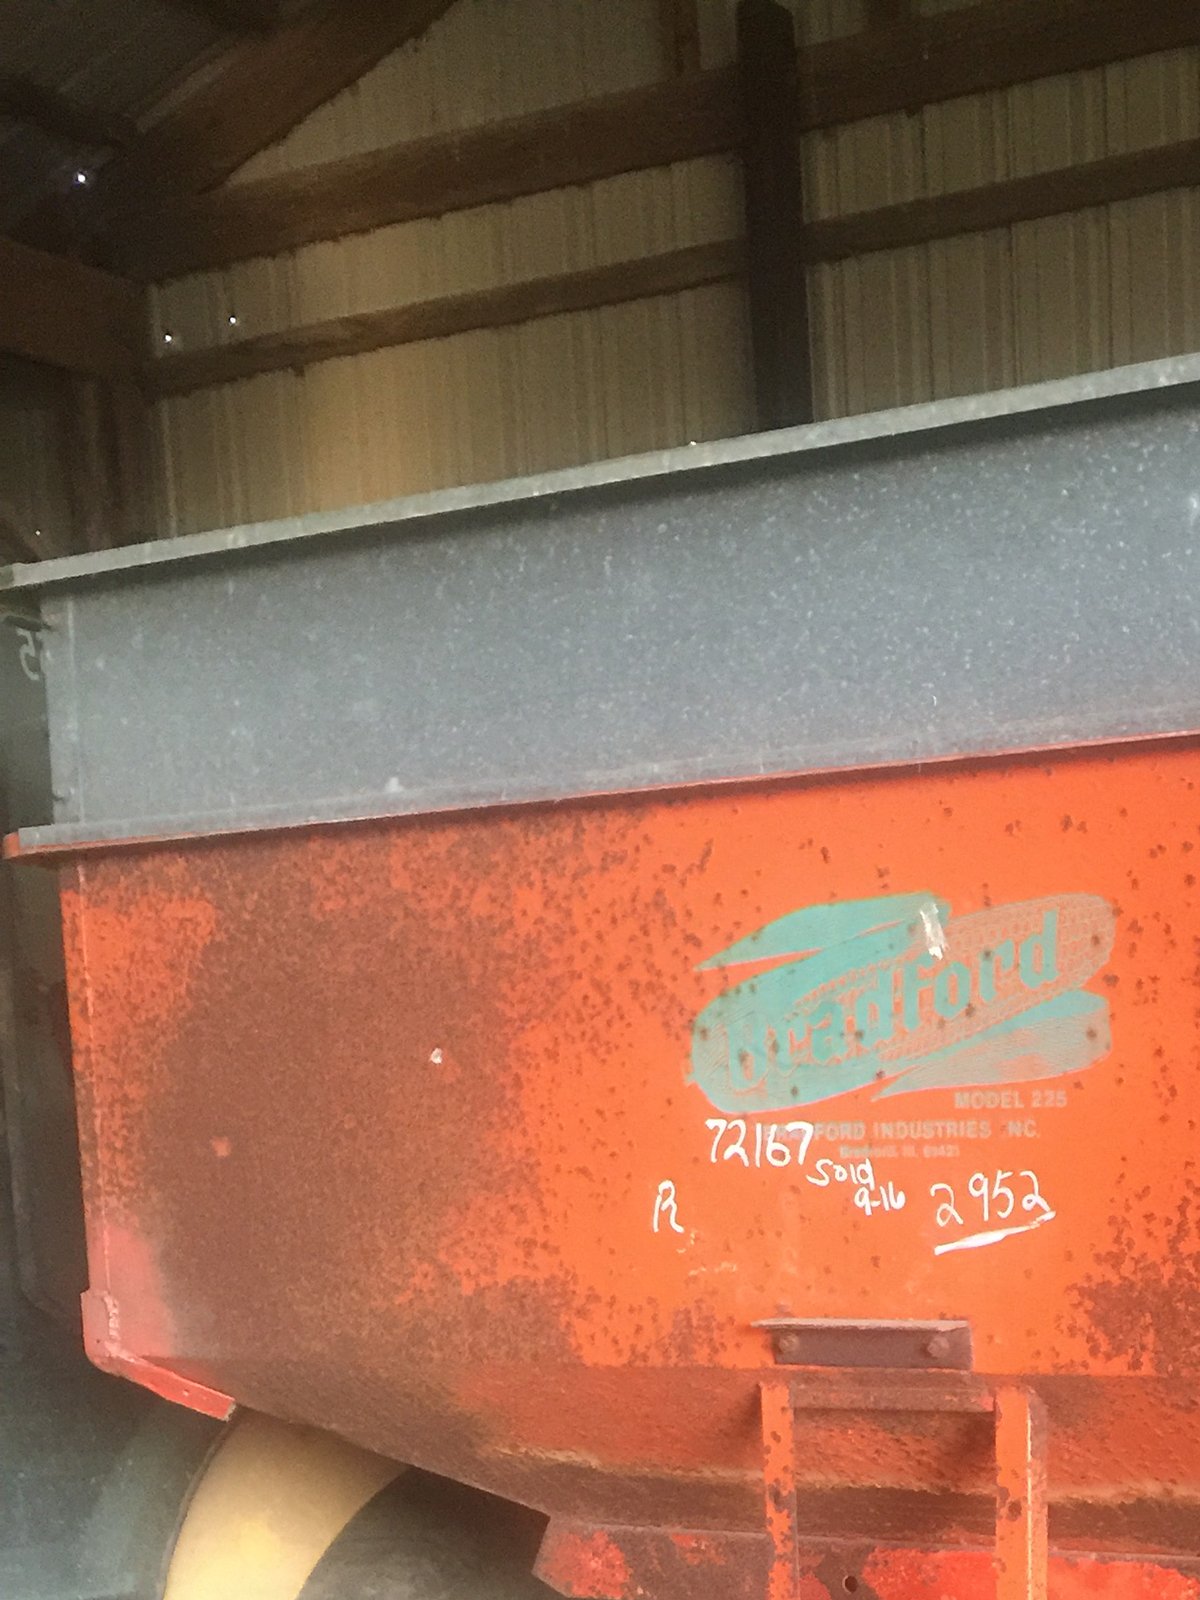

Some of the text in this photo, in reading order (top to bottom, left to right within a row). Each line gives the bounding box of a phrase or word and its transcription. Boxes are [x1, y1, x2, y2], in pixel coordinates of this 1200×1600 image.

[954, 1090, 1025, 1110] MODEL
[873, 1119, 992, 1140] INDUSTRIES
[1000, 1118, 1041, 1139] NC.
[704, 1118, 815, 1167] 72167
